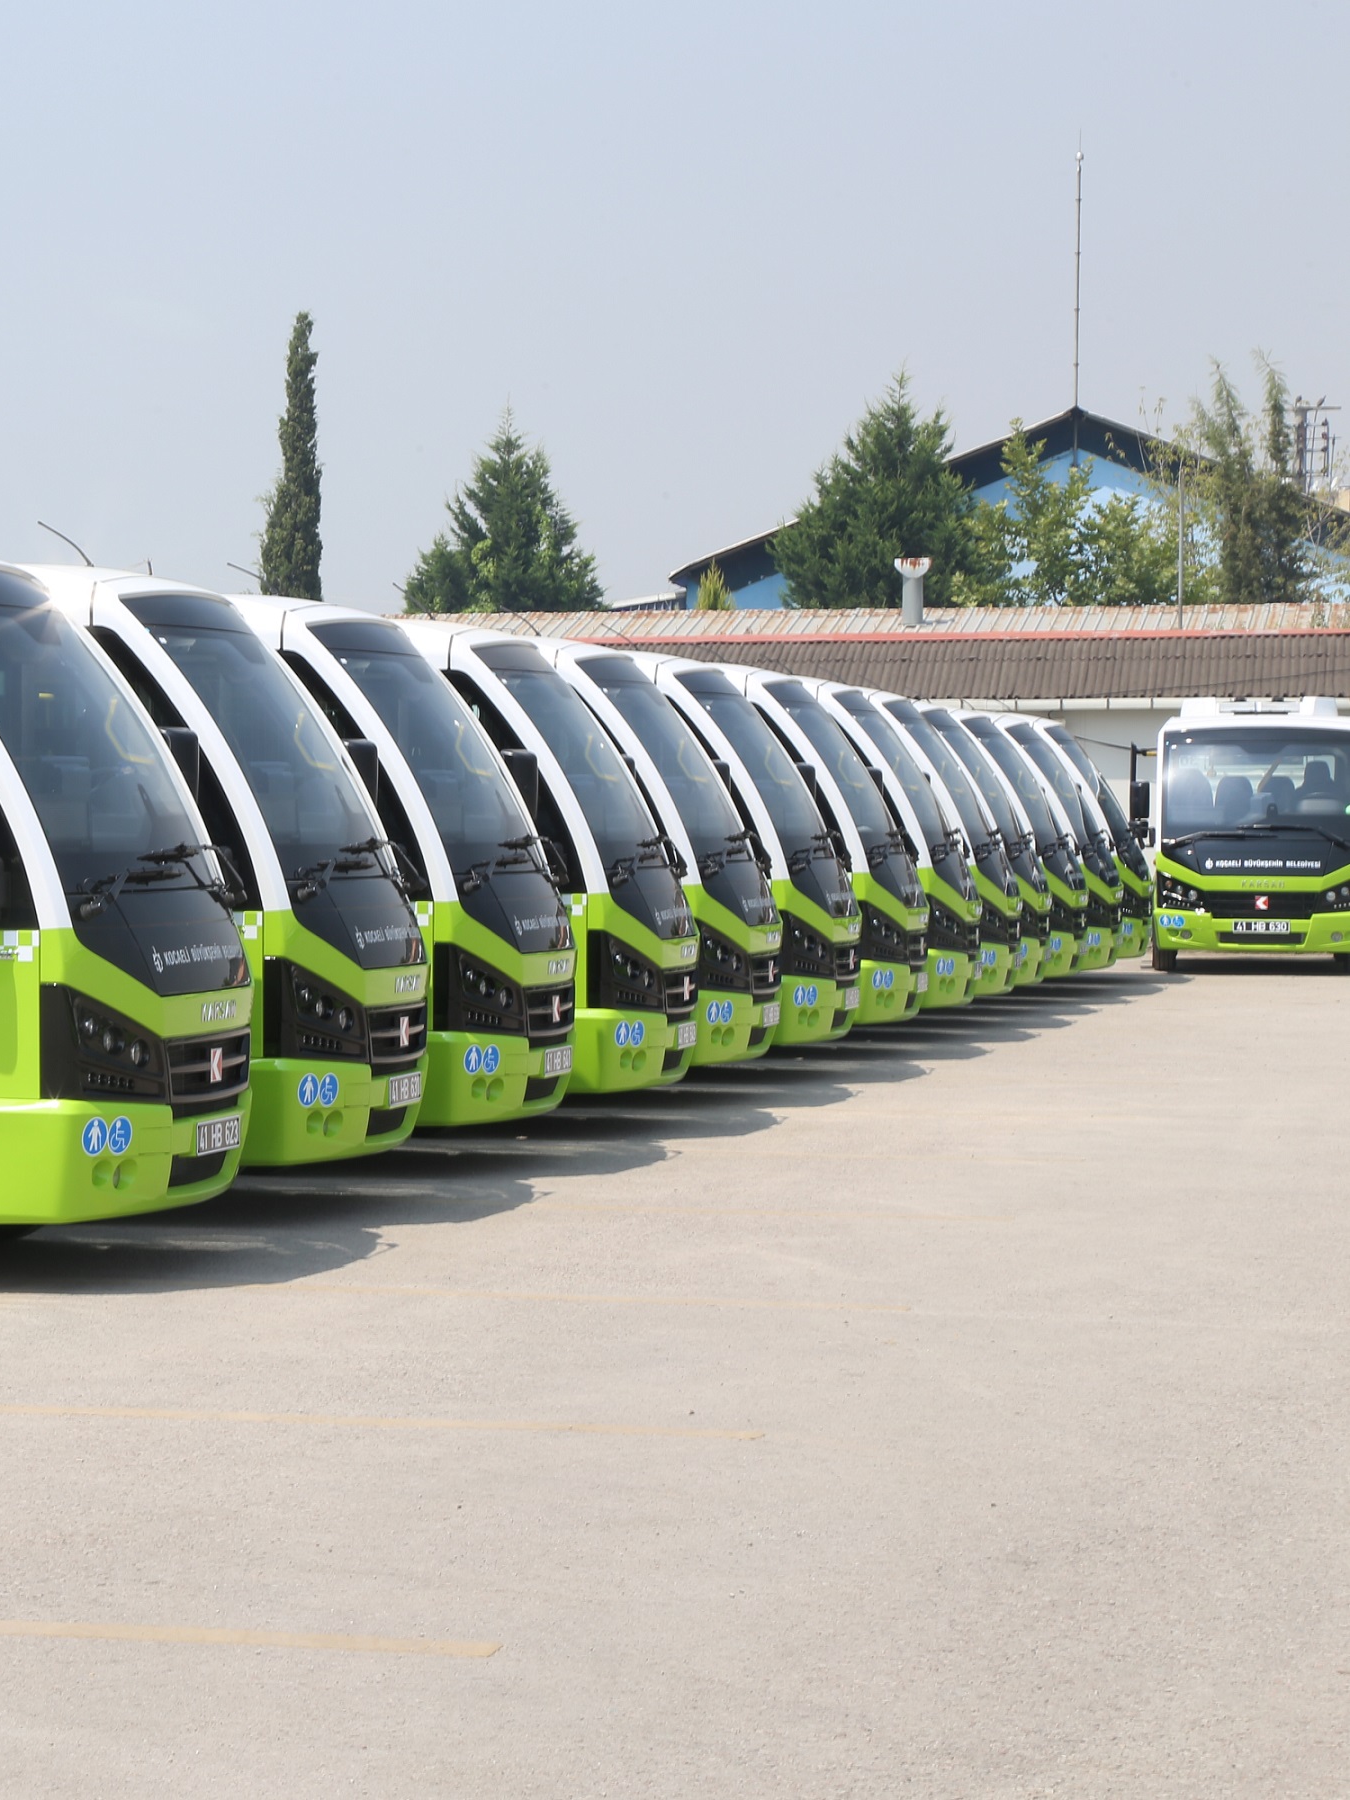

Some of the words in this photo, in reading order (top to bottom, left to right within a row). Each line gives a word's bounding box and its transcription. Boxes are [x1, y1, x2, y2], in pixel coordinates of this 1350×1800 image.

[1236, 921, 1246, 931] 41
[1251, 921, 1266, 931] HB
[1269, 921, 1287, 931] 630
[400, 1078, 409, 1100] HB
[199, 1125, 208, 1151] 41
[210, 1122, 223, 1149] HB
[225, 1119, 239, 1146] 623
